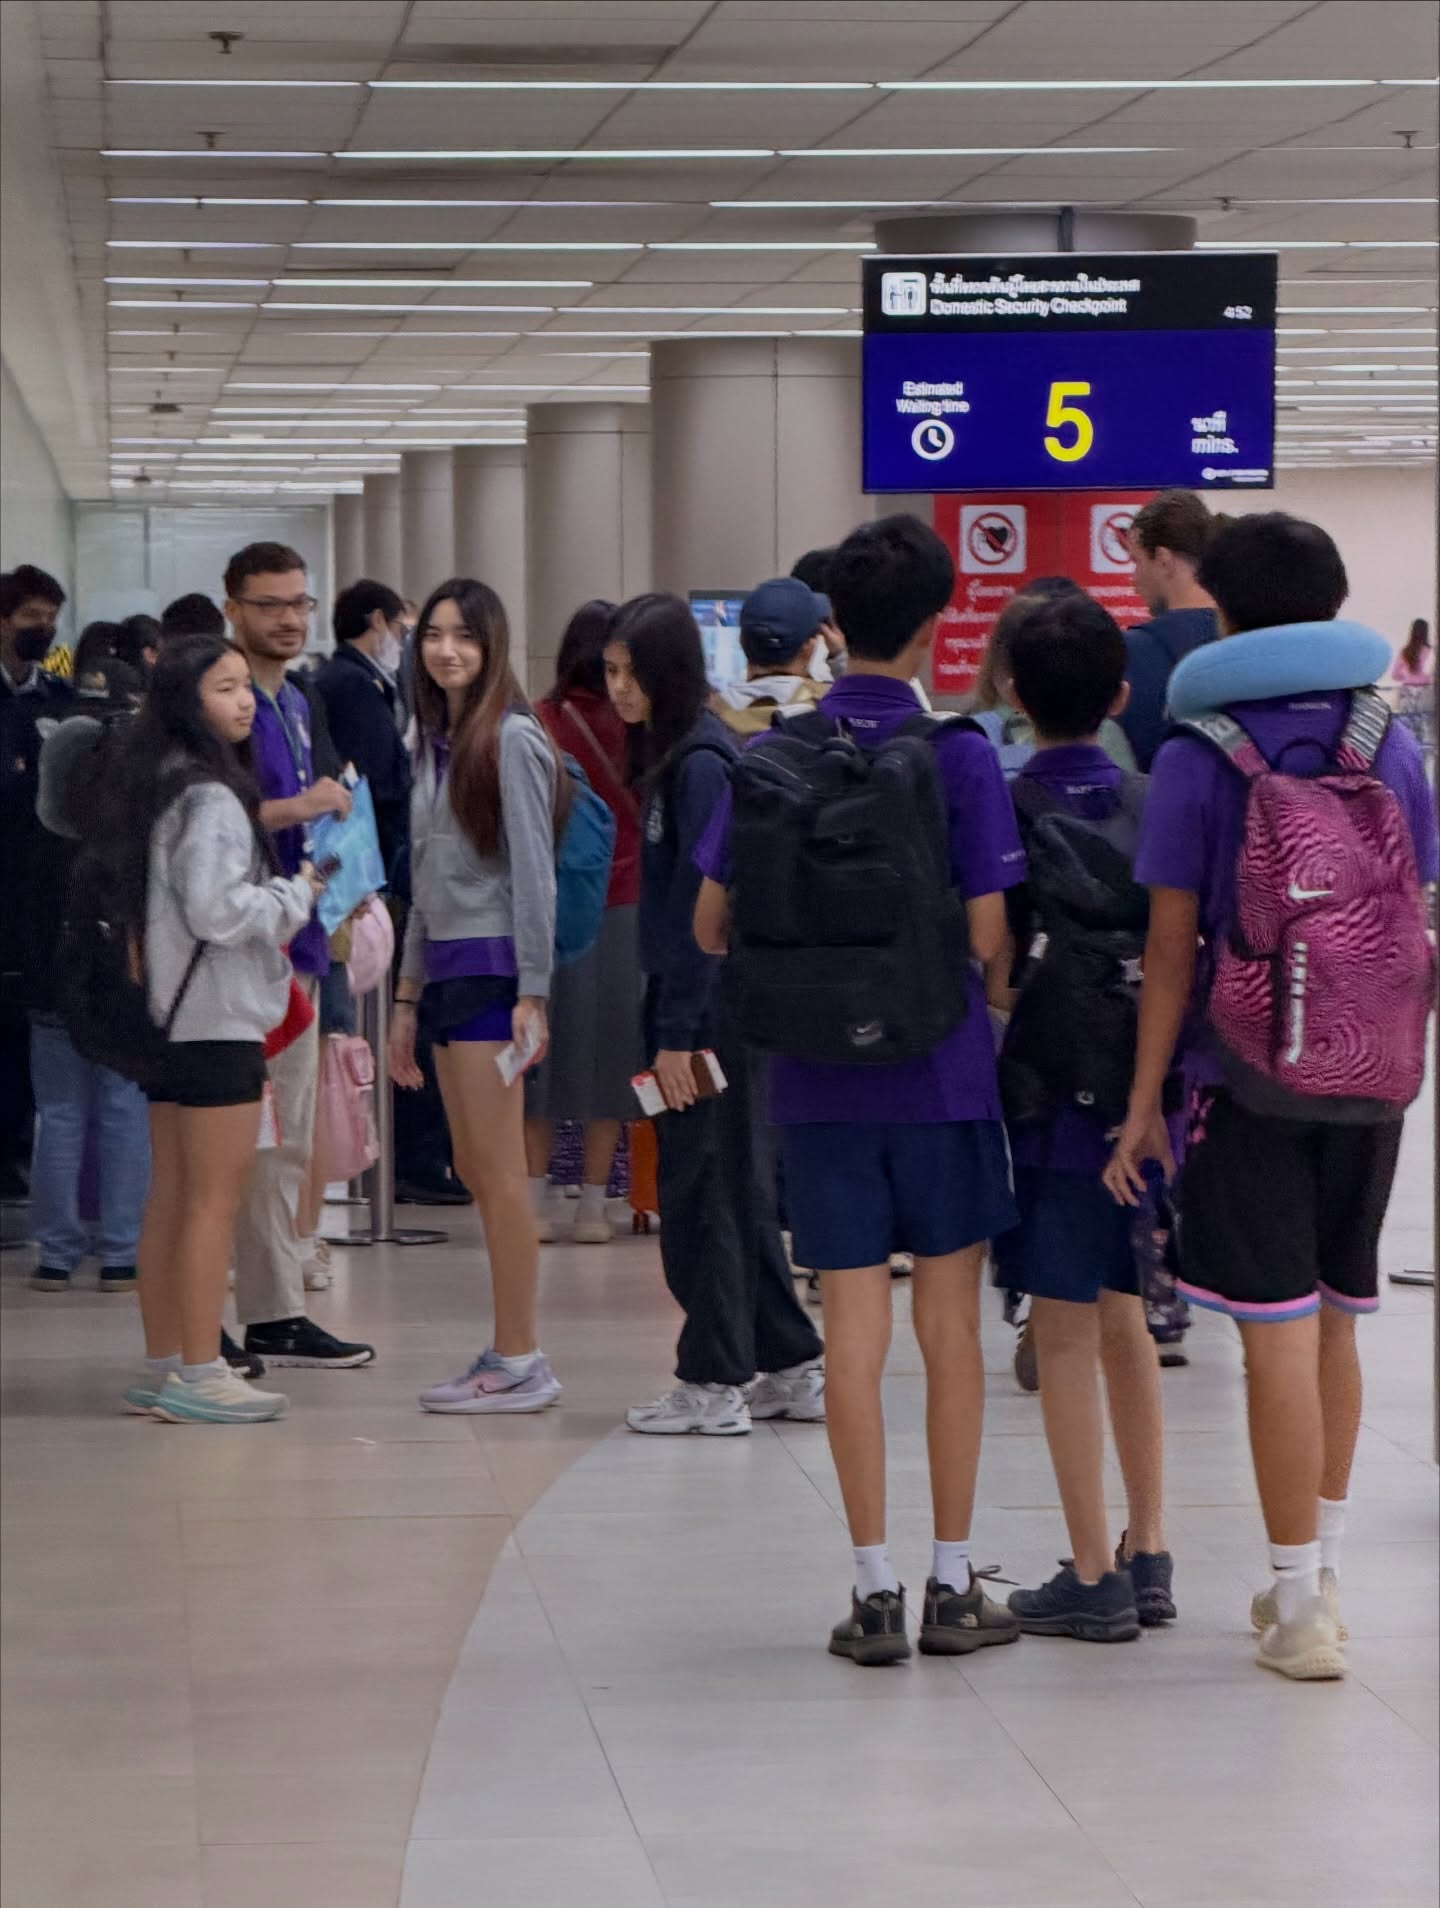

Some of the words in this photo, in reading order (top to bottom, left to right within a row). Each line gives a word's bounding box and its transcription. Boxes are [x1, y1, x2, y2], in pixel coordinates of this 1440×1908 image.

[930, 299, 993, 315] Domestic
[994, 298, 1049, 317] Security
[1050, 297, 1127, 316] Checkpoint
[903, 381, 963, 396] Estimated
[896, 399, 942, 416] Waiting
[1043, 381, 1094, 462] 5
[1191, 435, 1239, 454] mins.
